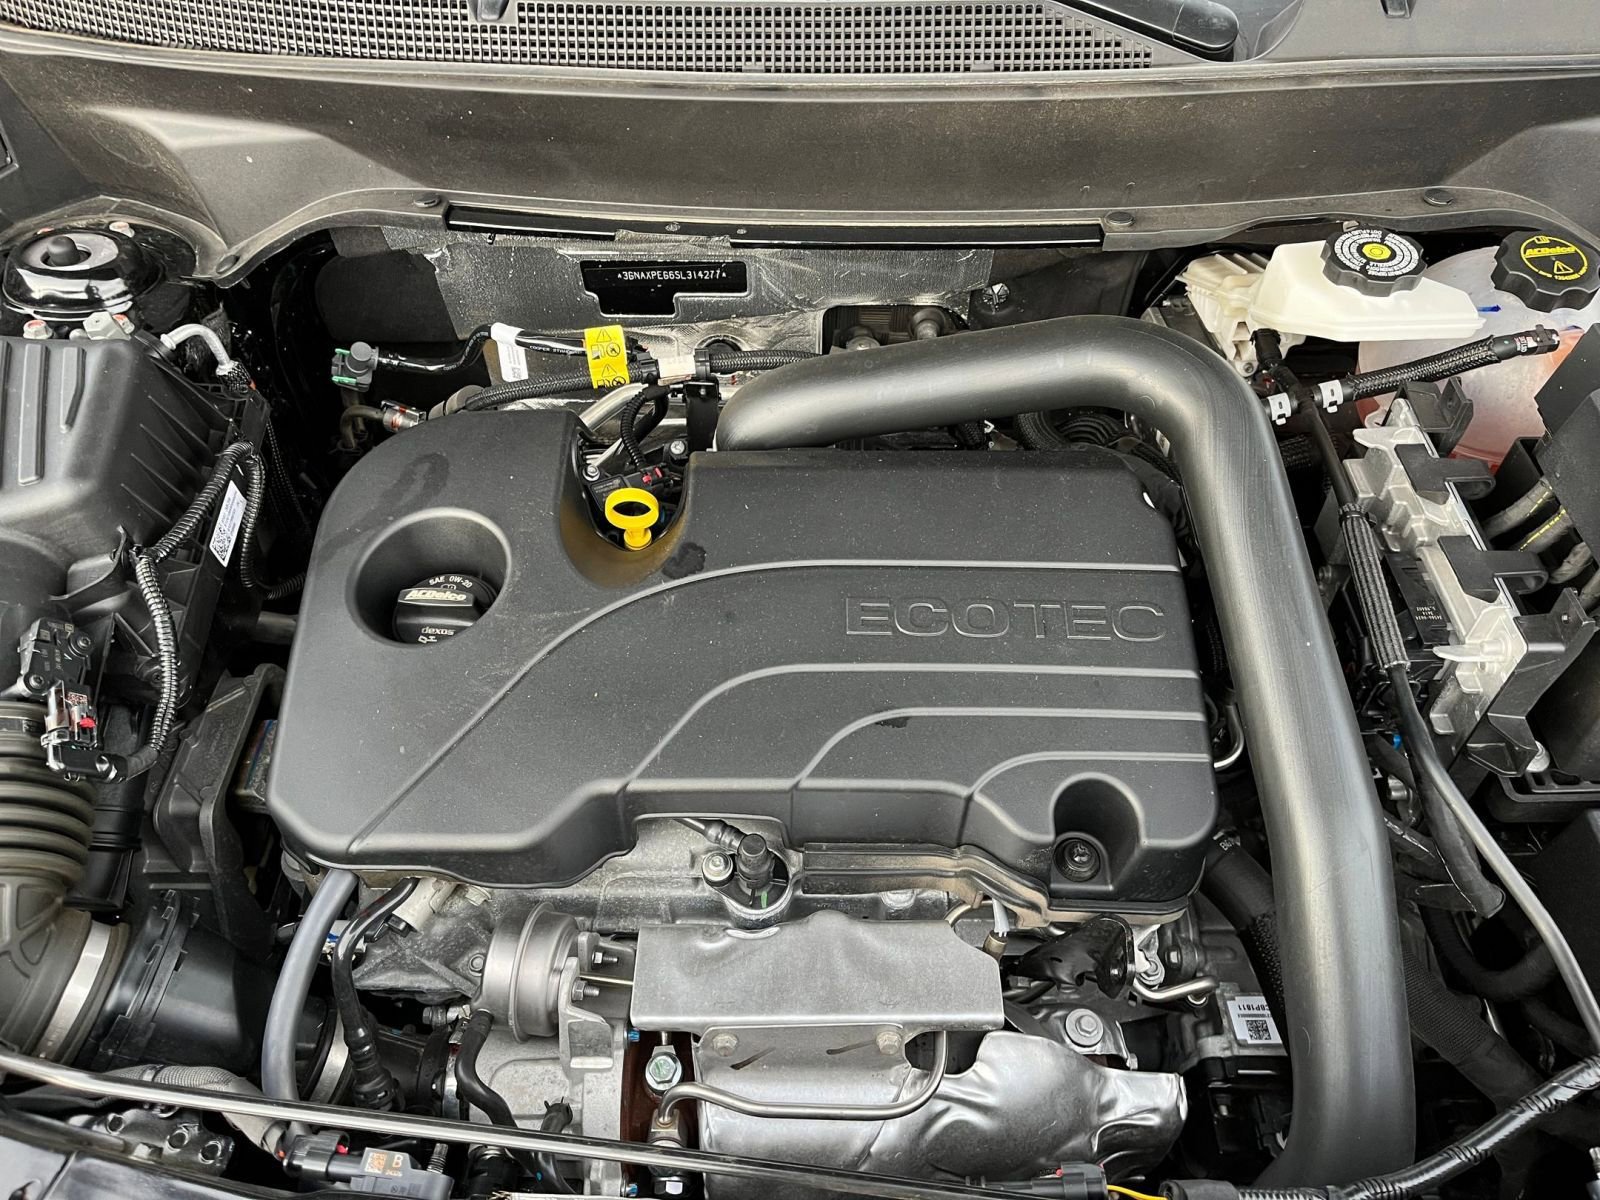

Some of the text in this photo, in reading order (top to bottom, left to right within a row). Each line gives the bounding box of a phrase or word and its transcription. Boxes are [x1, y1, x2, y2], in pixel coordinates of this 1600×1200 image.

[1525, 246, 1576, 257] ACDelco
[429, 575, 473, 589] SAE 0W-20
[404, 590, 467, 602] ACDelco
[845, 597, 1167, 642] ECOTEC
[421, 626, 456, 636] dexos
[392, 1154, 404, 1168] B
